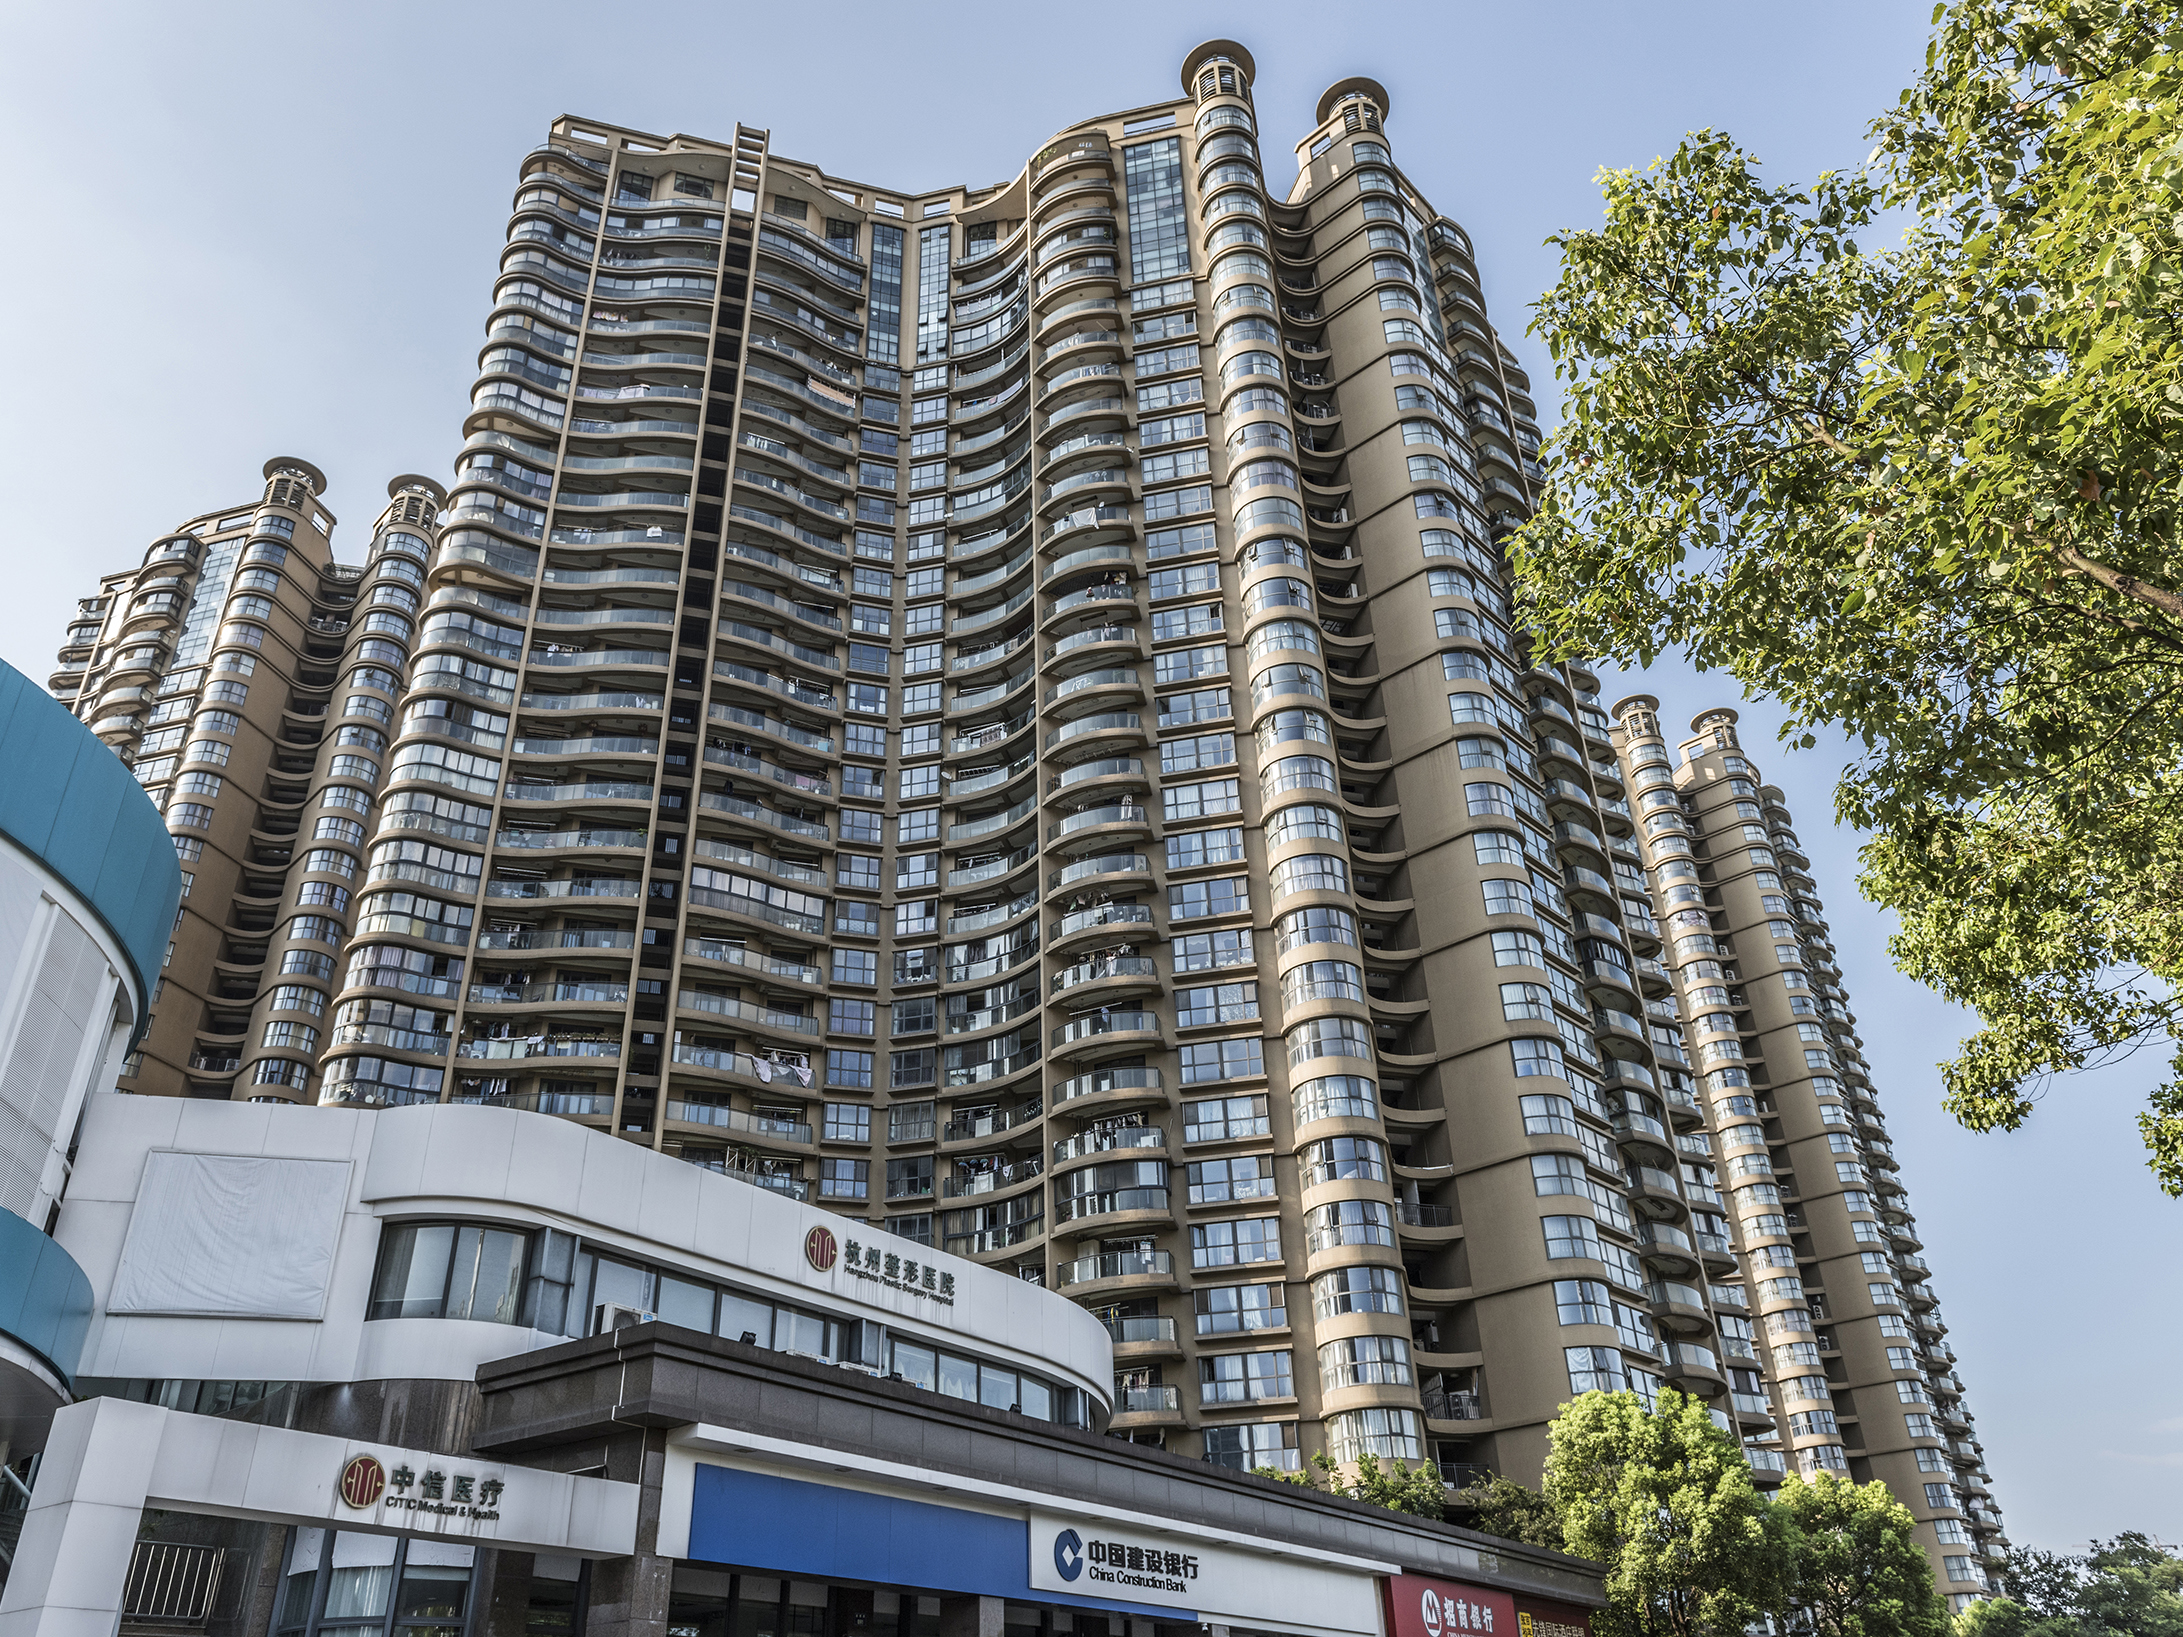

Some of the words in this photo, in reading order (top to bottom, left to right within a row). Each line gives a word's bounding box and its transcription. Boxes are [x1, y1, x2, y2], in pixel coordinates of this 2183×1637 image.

[844, 1264, 879, 1282] Hangzhou
[879, 1275, 902, 1290] Plastic
[902, 1283, 928, 1299] Surgery
[928, 1291, 954, 1307] Hospital
[845, 1239, 955, 1296] 杭州整形医院
[391, 1465, 505, 1507] 中信医疗
[386, 1496, 417, 1510] CITIC
[417, 1502, 458, 1518] Medical
[459, 1506, 467, 1517] &
[468, 1507, 500, 1521] Health
[1088, 1540, 1199, 1580] 中国建设银行
[1089, 1566, 1115, 1582] China
[1116, 1570, 1165, 1590] Construction
[1166, 1578, 1187, 1593] Bank
[1443, 1596, 1494, 1633] 招商银行
